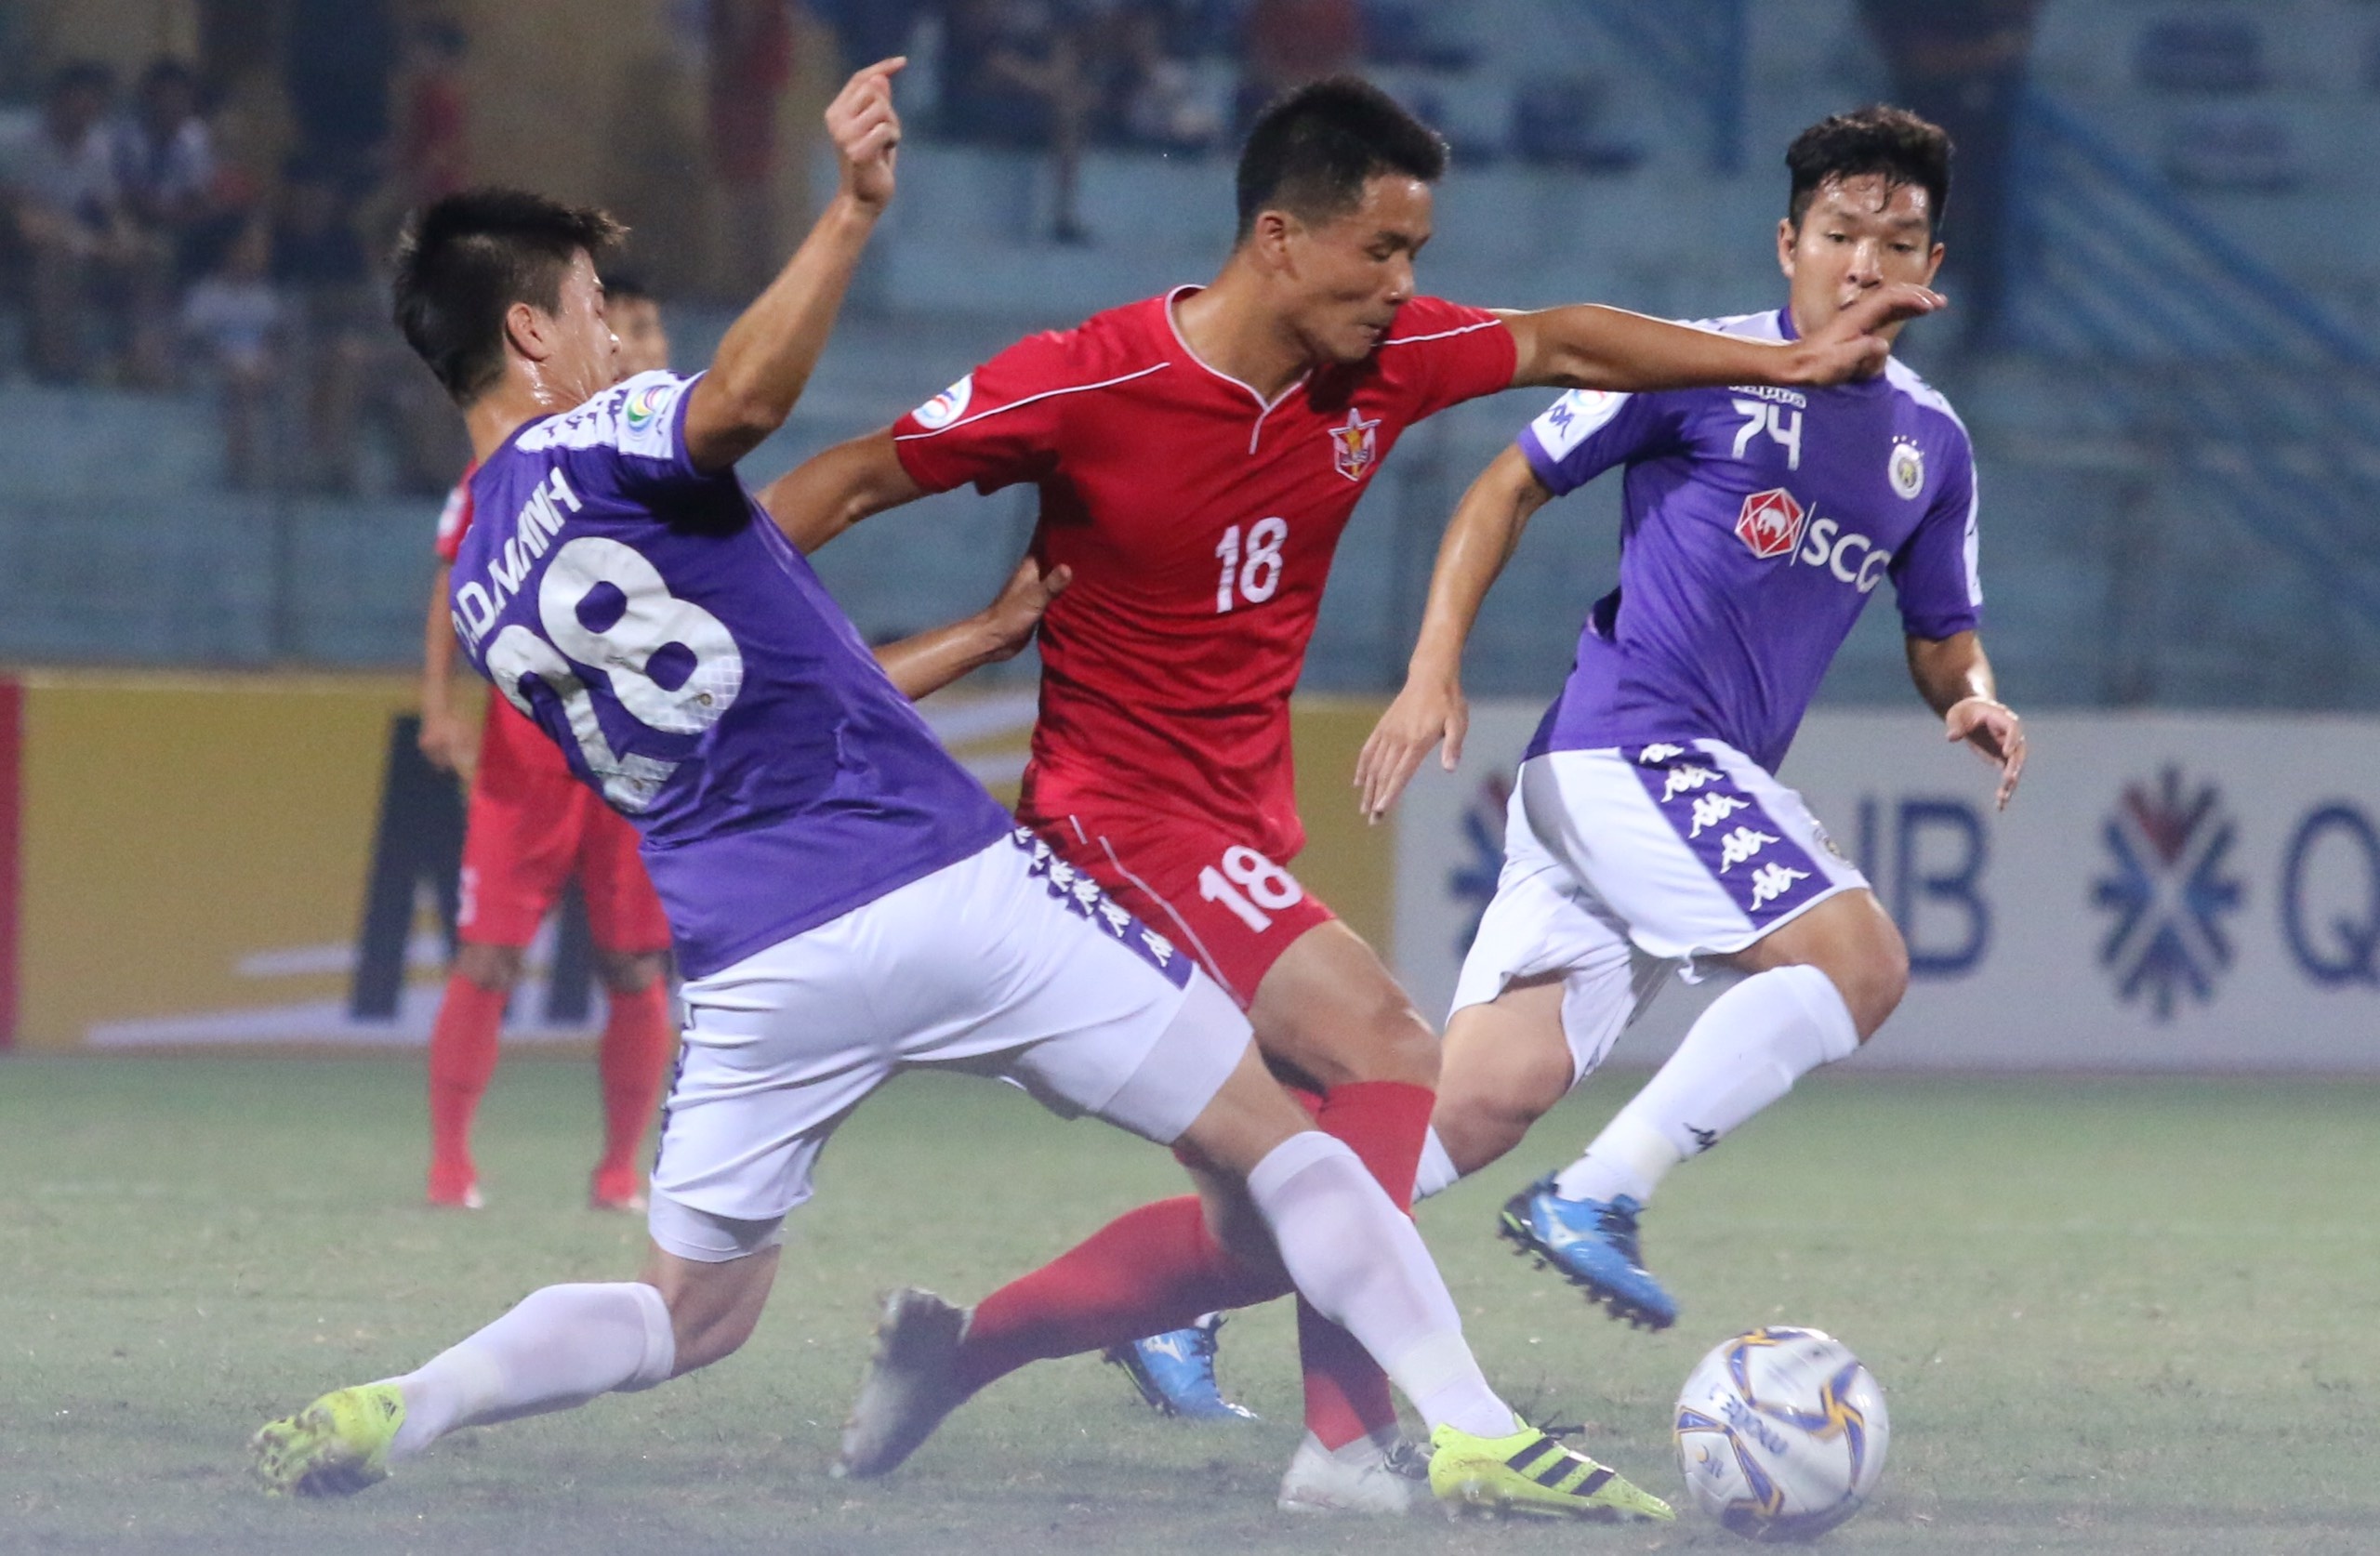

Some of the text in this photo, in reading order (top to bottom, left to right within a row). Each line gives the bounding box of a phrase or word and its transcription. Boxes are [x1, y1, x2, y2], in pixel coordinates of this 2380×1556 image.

[1731, 399, 1803, 472] 74
[1215, 516, 1289, 613] 18
[485, 536, 744, 814] 28
[1198, 844, 1303, 933] 18
